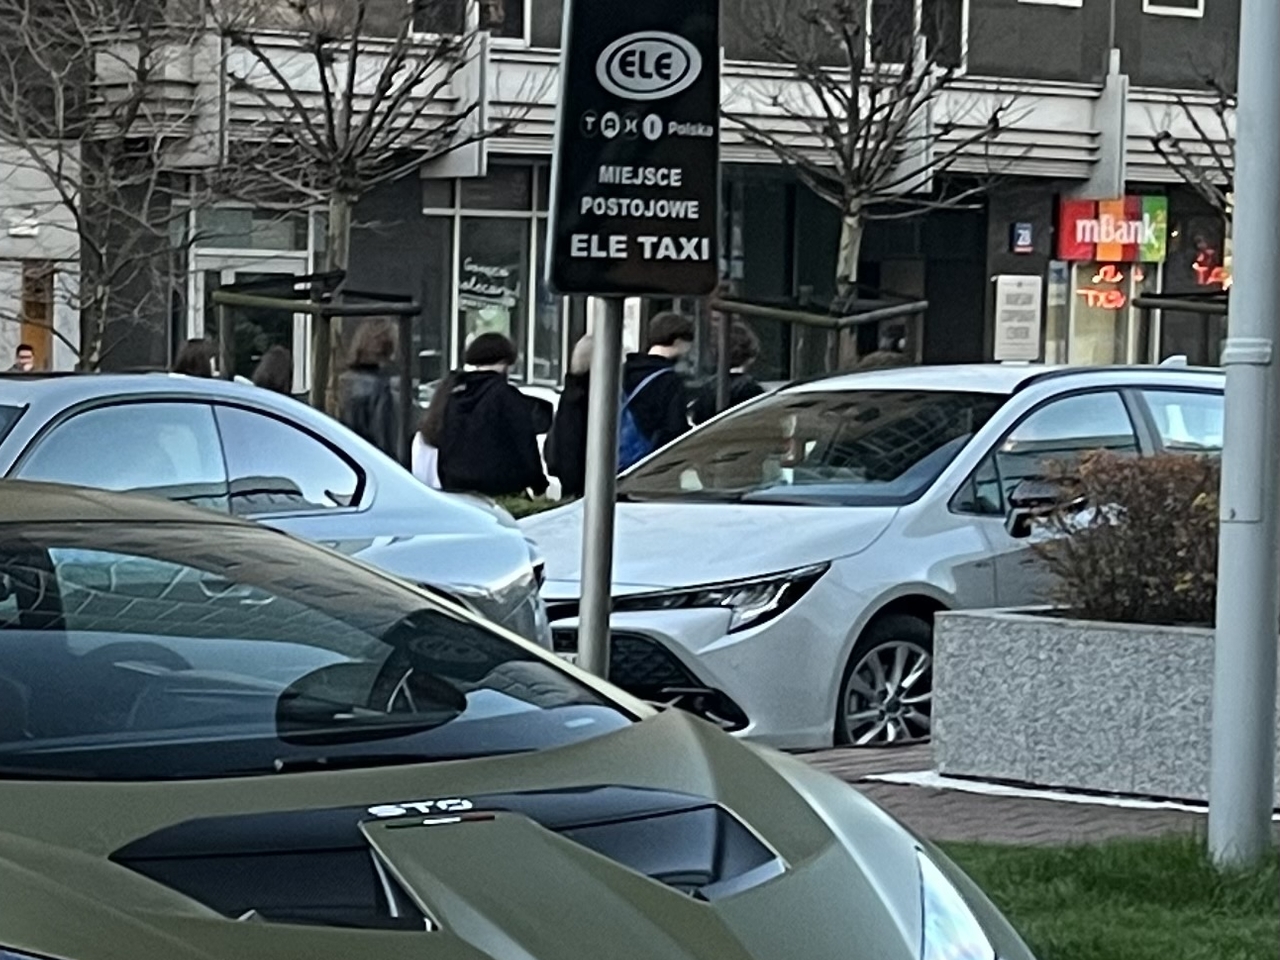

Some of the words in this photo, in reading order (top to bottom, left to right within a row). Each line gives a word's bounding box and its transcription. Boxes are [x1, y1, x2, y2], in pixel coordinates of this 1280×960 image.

[618, 49, 673, 80] ELE
[667, 120, 714, 137] Polska
[598, 165, 682, 187] MIEJSCE
[580, 196, 700, 219] POSTOJOWE
[1075, 212, 1159, 248] mBank
[570, 233, 629, 259] ELE
[636, 235, 710, 261] TAXI
